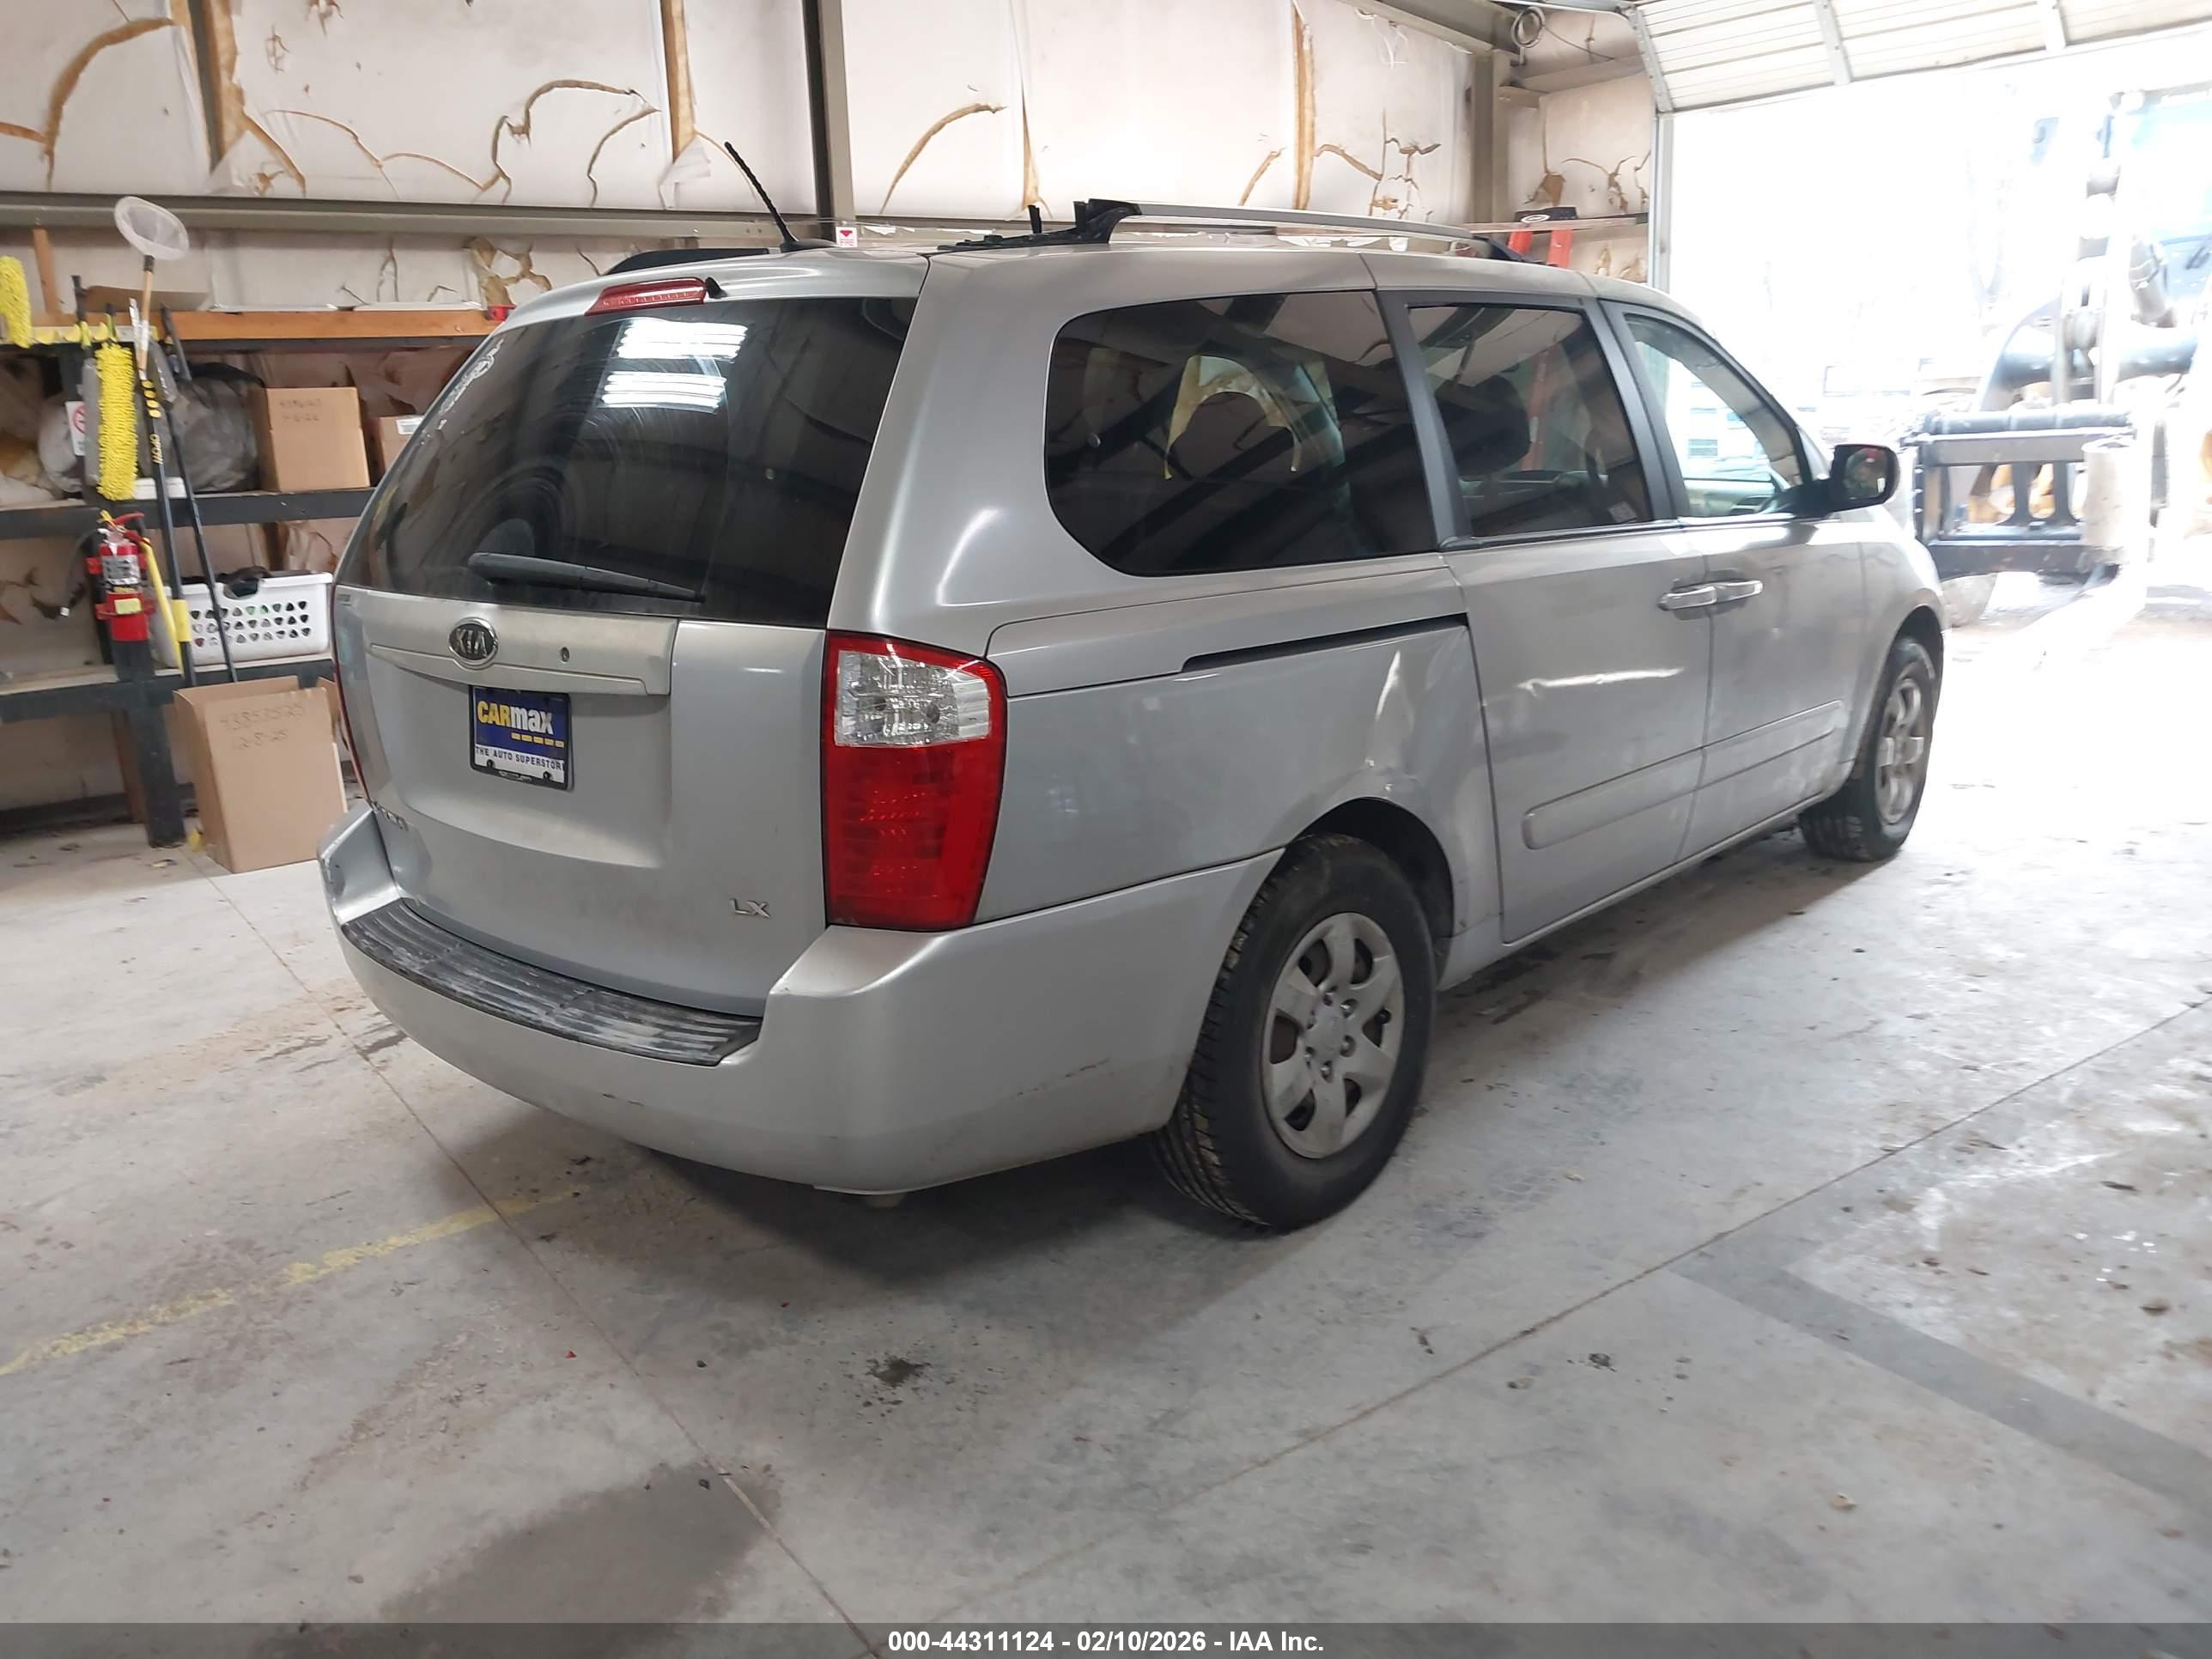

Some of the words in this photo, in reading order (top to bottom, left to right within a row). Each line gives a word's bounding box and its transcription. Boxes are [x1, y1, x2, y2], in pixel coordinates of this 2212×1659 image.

[455, 628, 488, 658] KIA
[475, 745, 489, 757] THE
[493, 749, 514, 761] AUTO
[728, 897, 771, 919] LX
